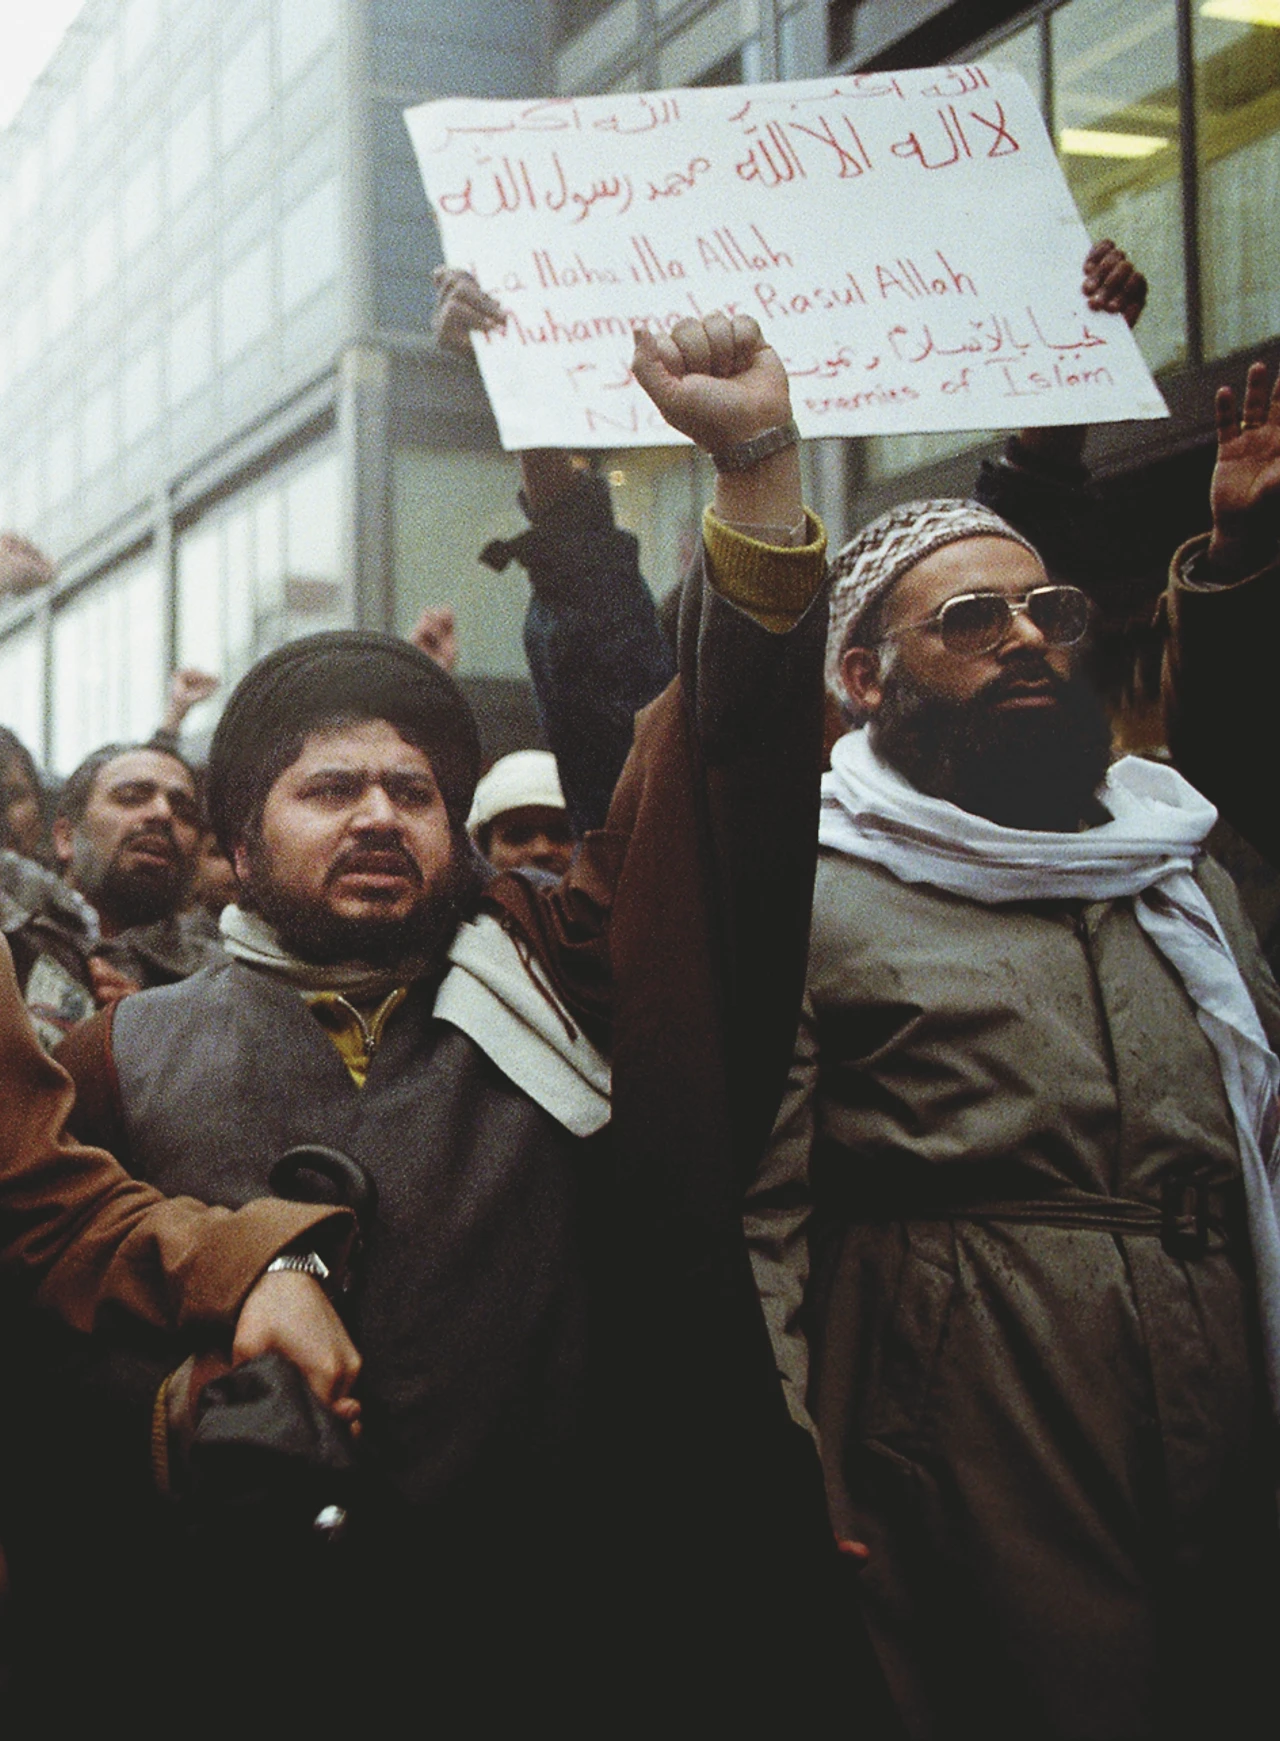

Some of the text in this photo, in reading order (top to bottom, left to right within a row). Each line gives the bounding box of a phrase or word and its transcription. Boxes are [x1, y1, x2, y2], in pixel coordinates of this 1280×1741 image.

[736, 119, 807, 189] الله
[970, 101, 1020, 158] لا
[439, 154, 537, 217] الله
[546, 151, 633, 224] رسول
[648, 157, 711, 202] محمد
[697, 224, 794, 274] Allah
[753, 272, 866, 319] Rasul
[875, 249, 978, 300] Allah
[941, 367, 972, 395] of
[983, 356, 1115, 398] Islam
